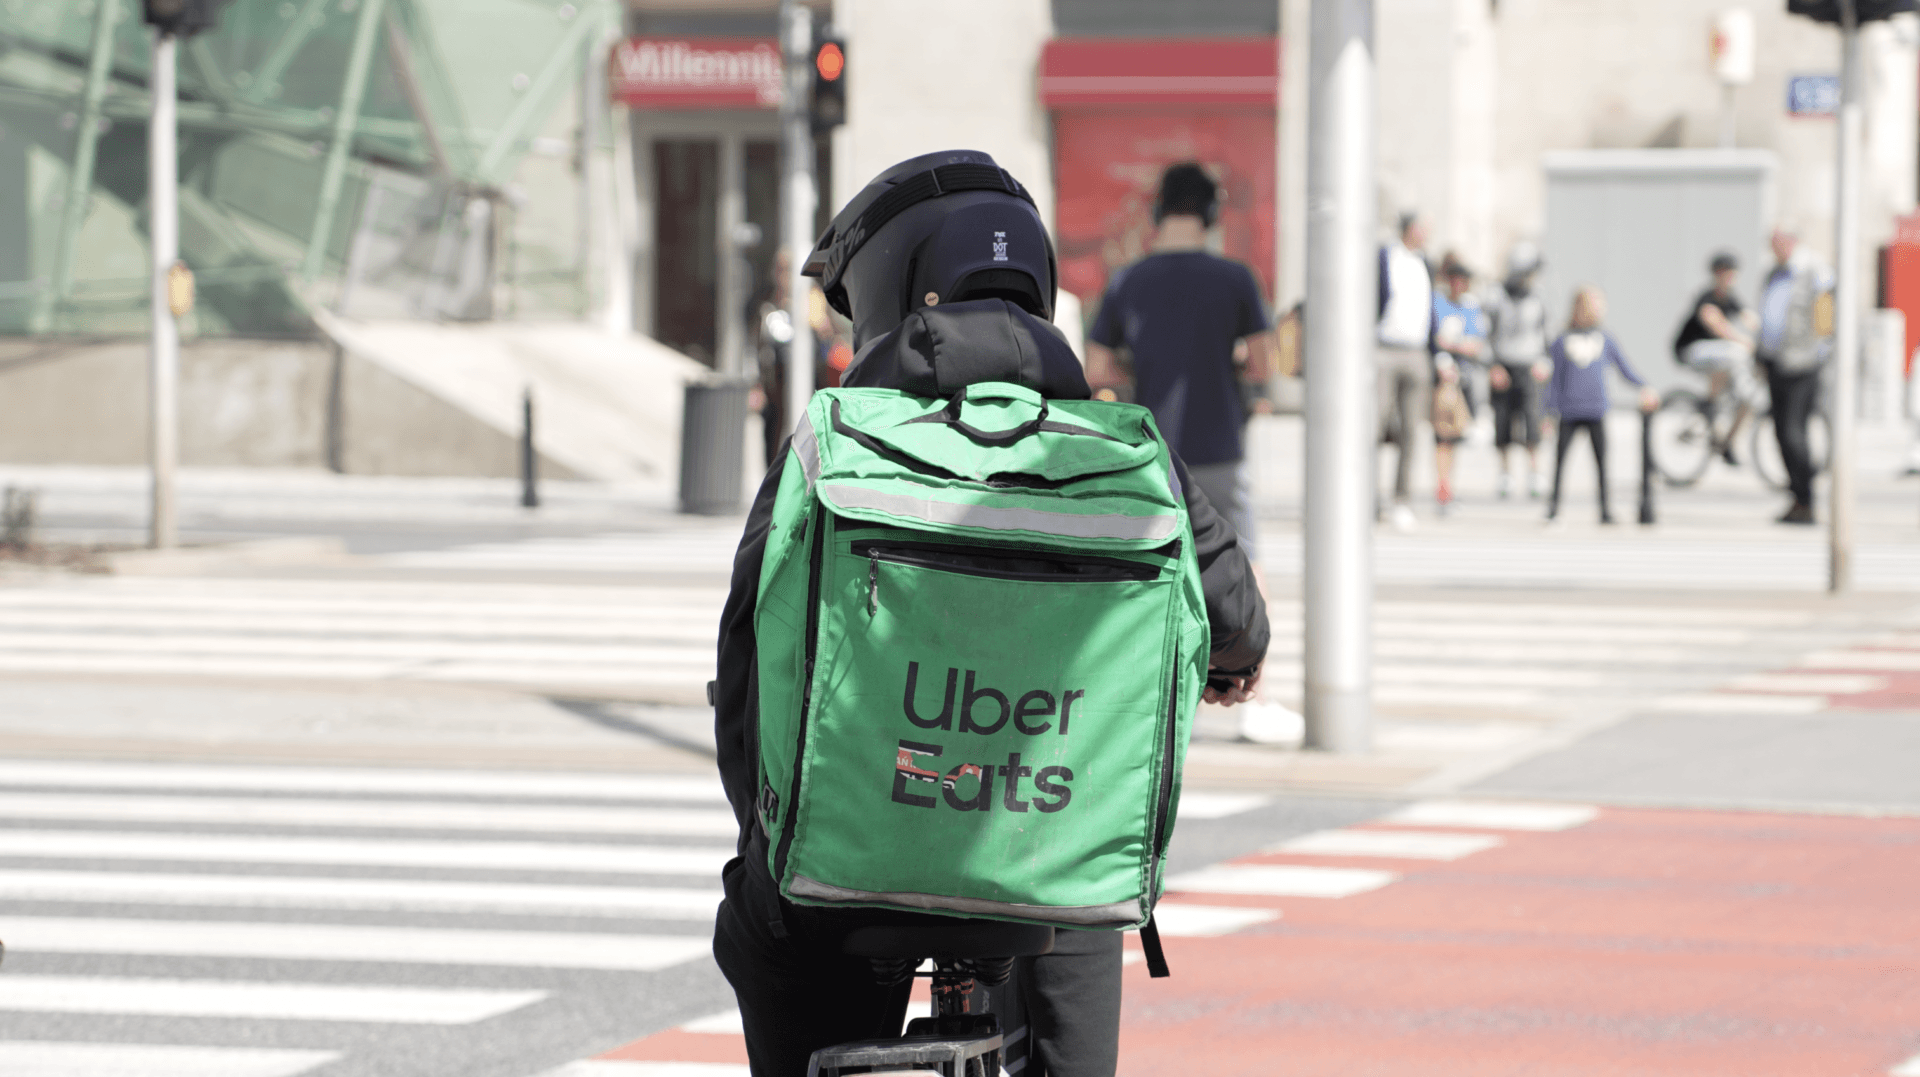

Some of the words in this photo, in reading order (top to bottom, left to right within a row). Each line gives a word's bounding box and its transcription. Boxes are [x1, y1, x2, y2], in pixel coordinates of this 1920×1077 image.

[993, 242, 1008, 254] DOT
[903, 661, 1085, 736] Uber
[891, 739, 1074, 813] Eats
